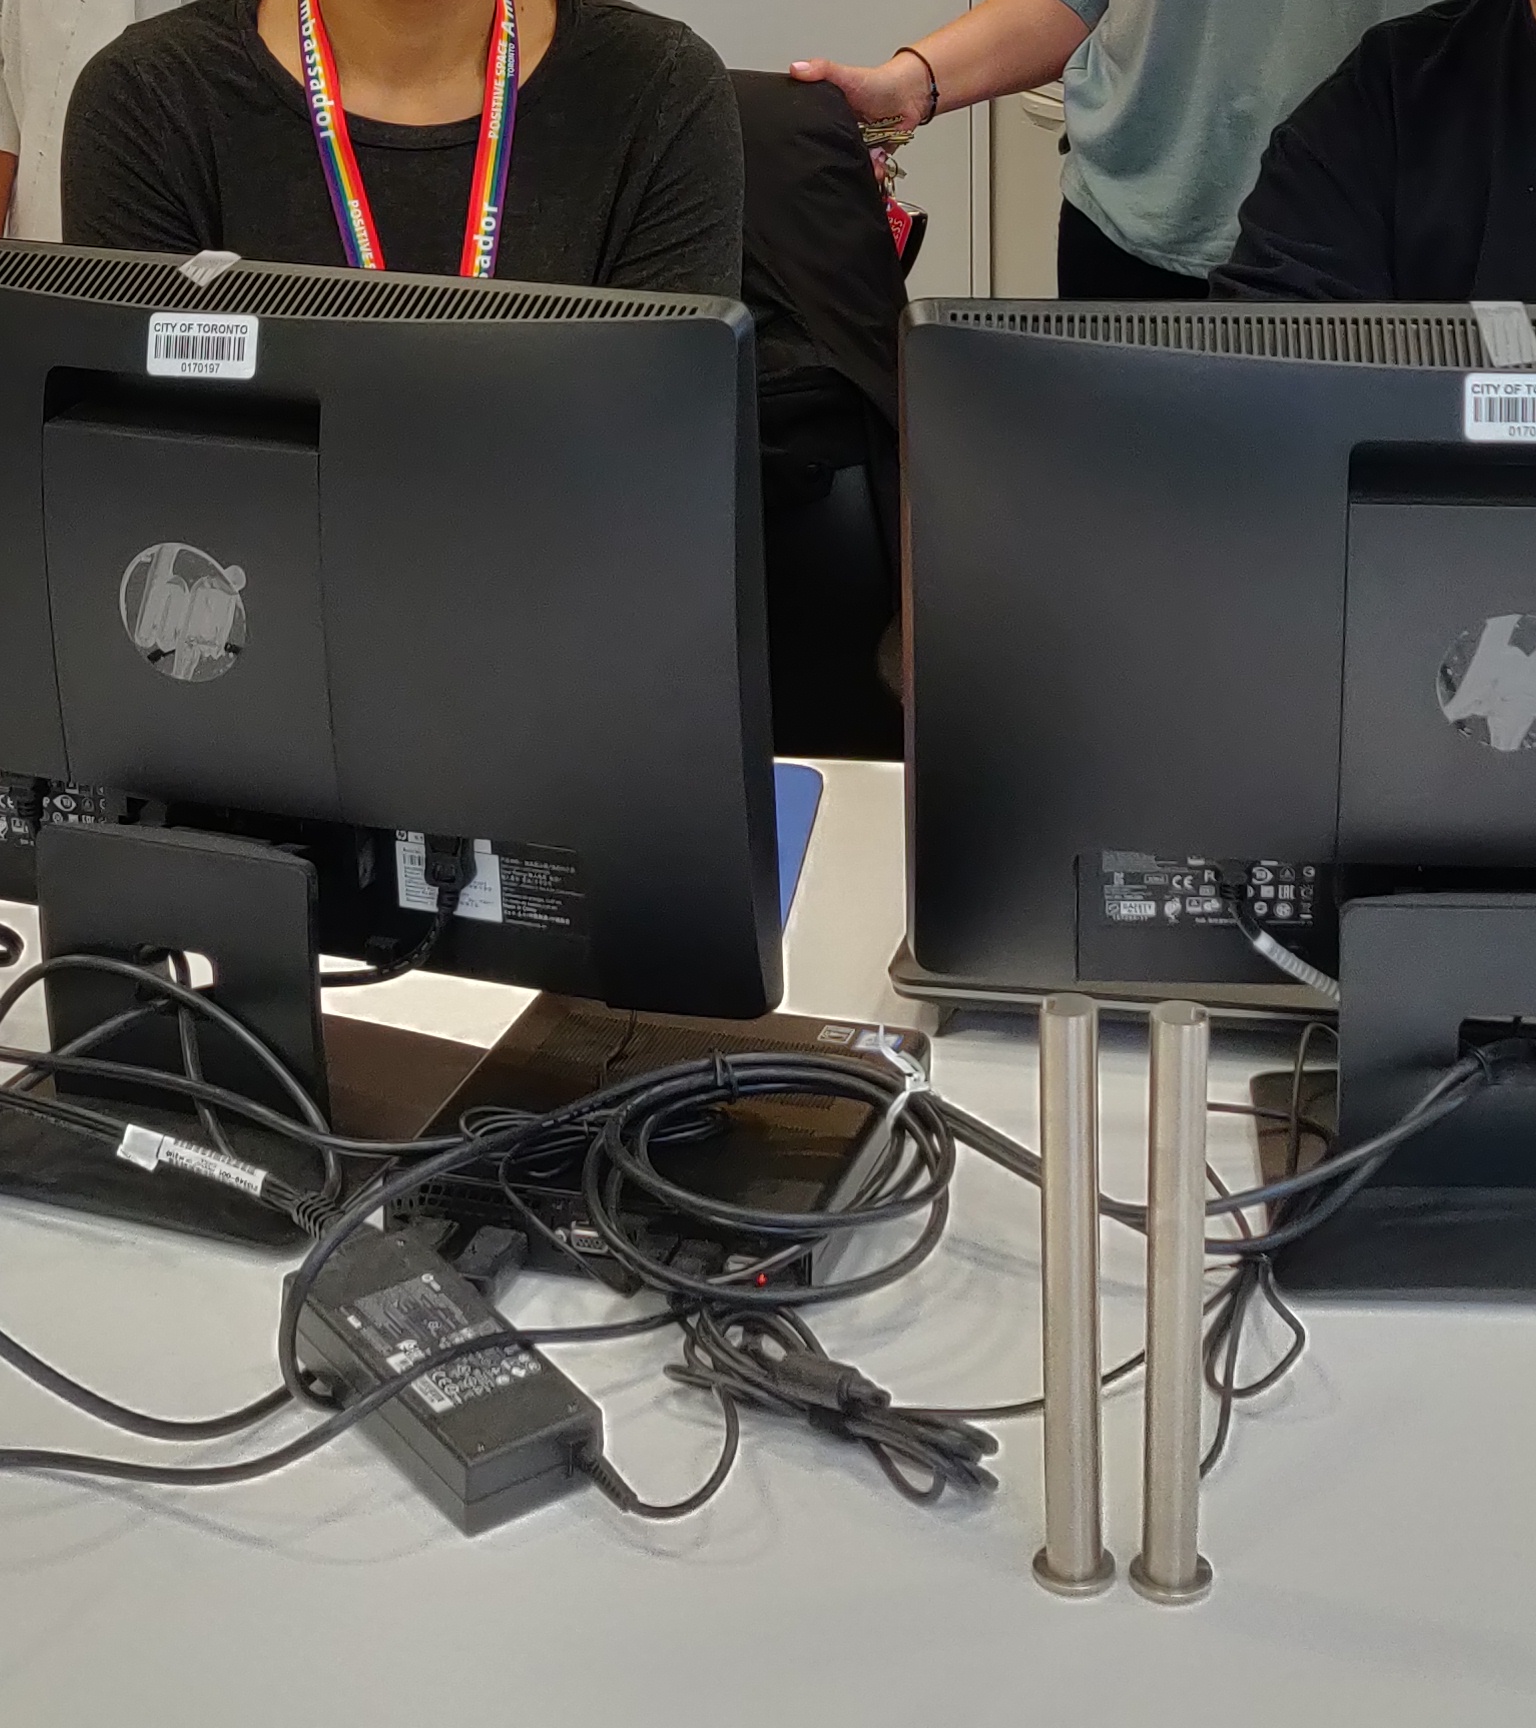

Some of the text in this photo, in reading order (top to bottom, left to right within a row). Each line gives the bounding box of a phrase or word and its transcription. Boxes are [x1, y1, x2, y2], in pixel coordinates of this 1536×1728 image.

[507, 42, 515, 78] TORONTO
[488, 38, 508, 139] POSITIVE SPACE
[348, 199, 373, 261] POSITIVE
[153, 322, 248, 335] CITY OF TORONTO
[181, 362, 220, 373] 0170197
[1471, 383, 1500, 395] CITY
[1503, 383, 1521, 395] OF
